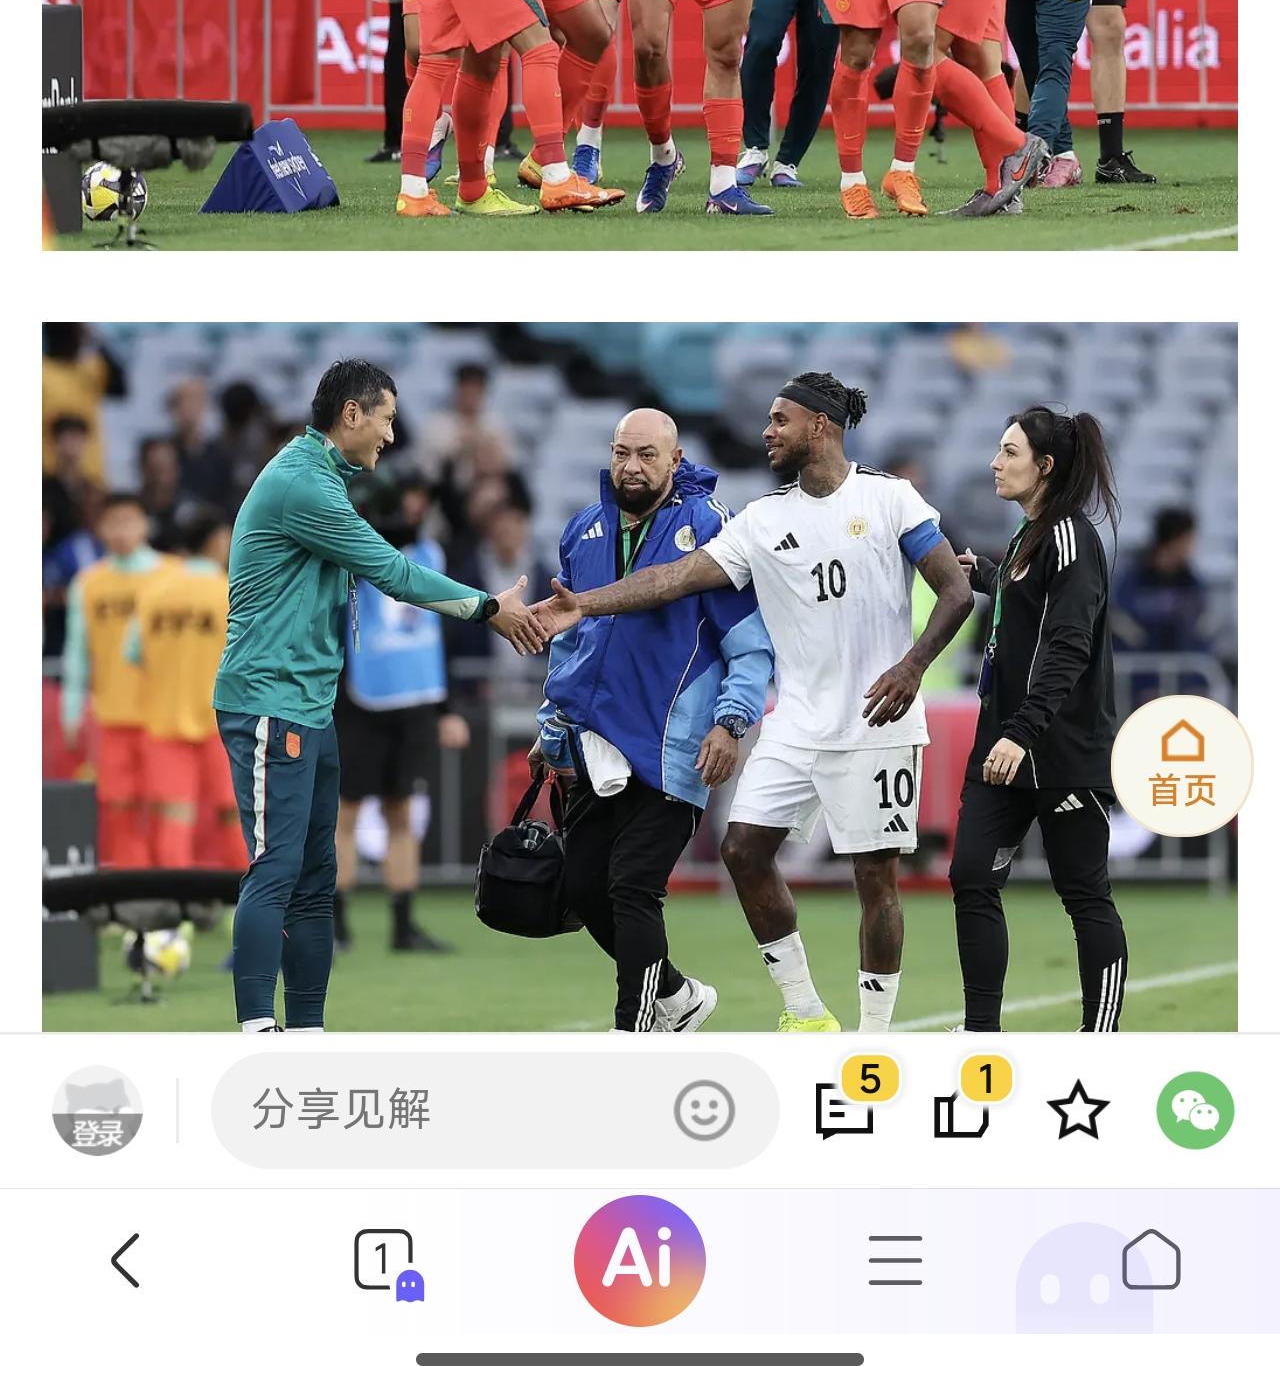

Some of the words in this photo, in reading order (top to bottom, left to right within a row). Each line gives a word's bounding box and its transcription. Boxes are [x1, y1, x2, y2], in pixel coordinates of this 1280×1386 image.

[810, 558, 847, 602] 10
[873, 768, 914, 809] 10
[1148, 773, 1217, 807] 首页
[860, 1063, 881, 1094] 5
[979, 1063, 992, 1094] 1
[252, 1087, 430, 1130] 分享见解
[72, 1120, 124, 1147] 登录
[375, 1242, 386, 1274] 1
[602, 1226, 671, 1287] Ai
